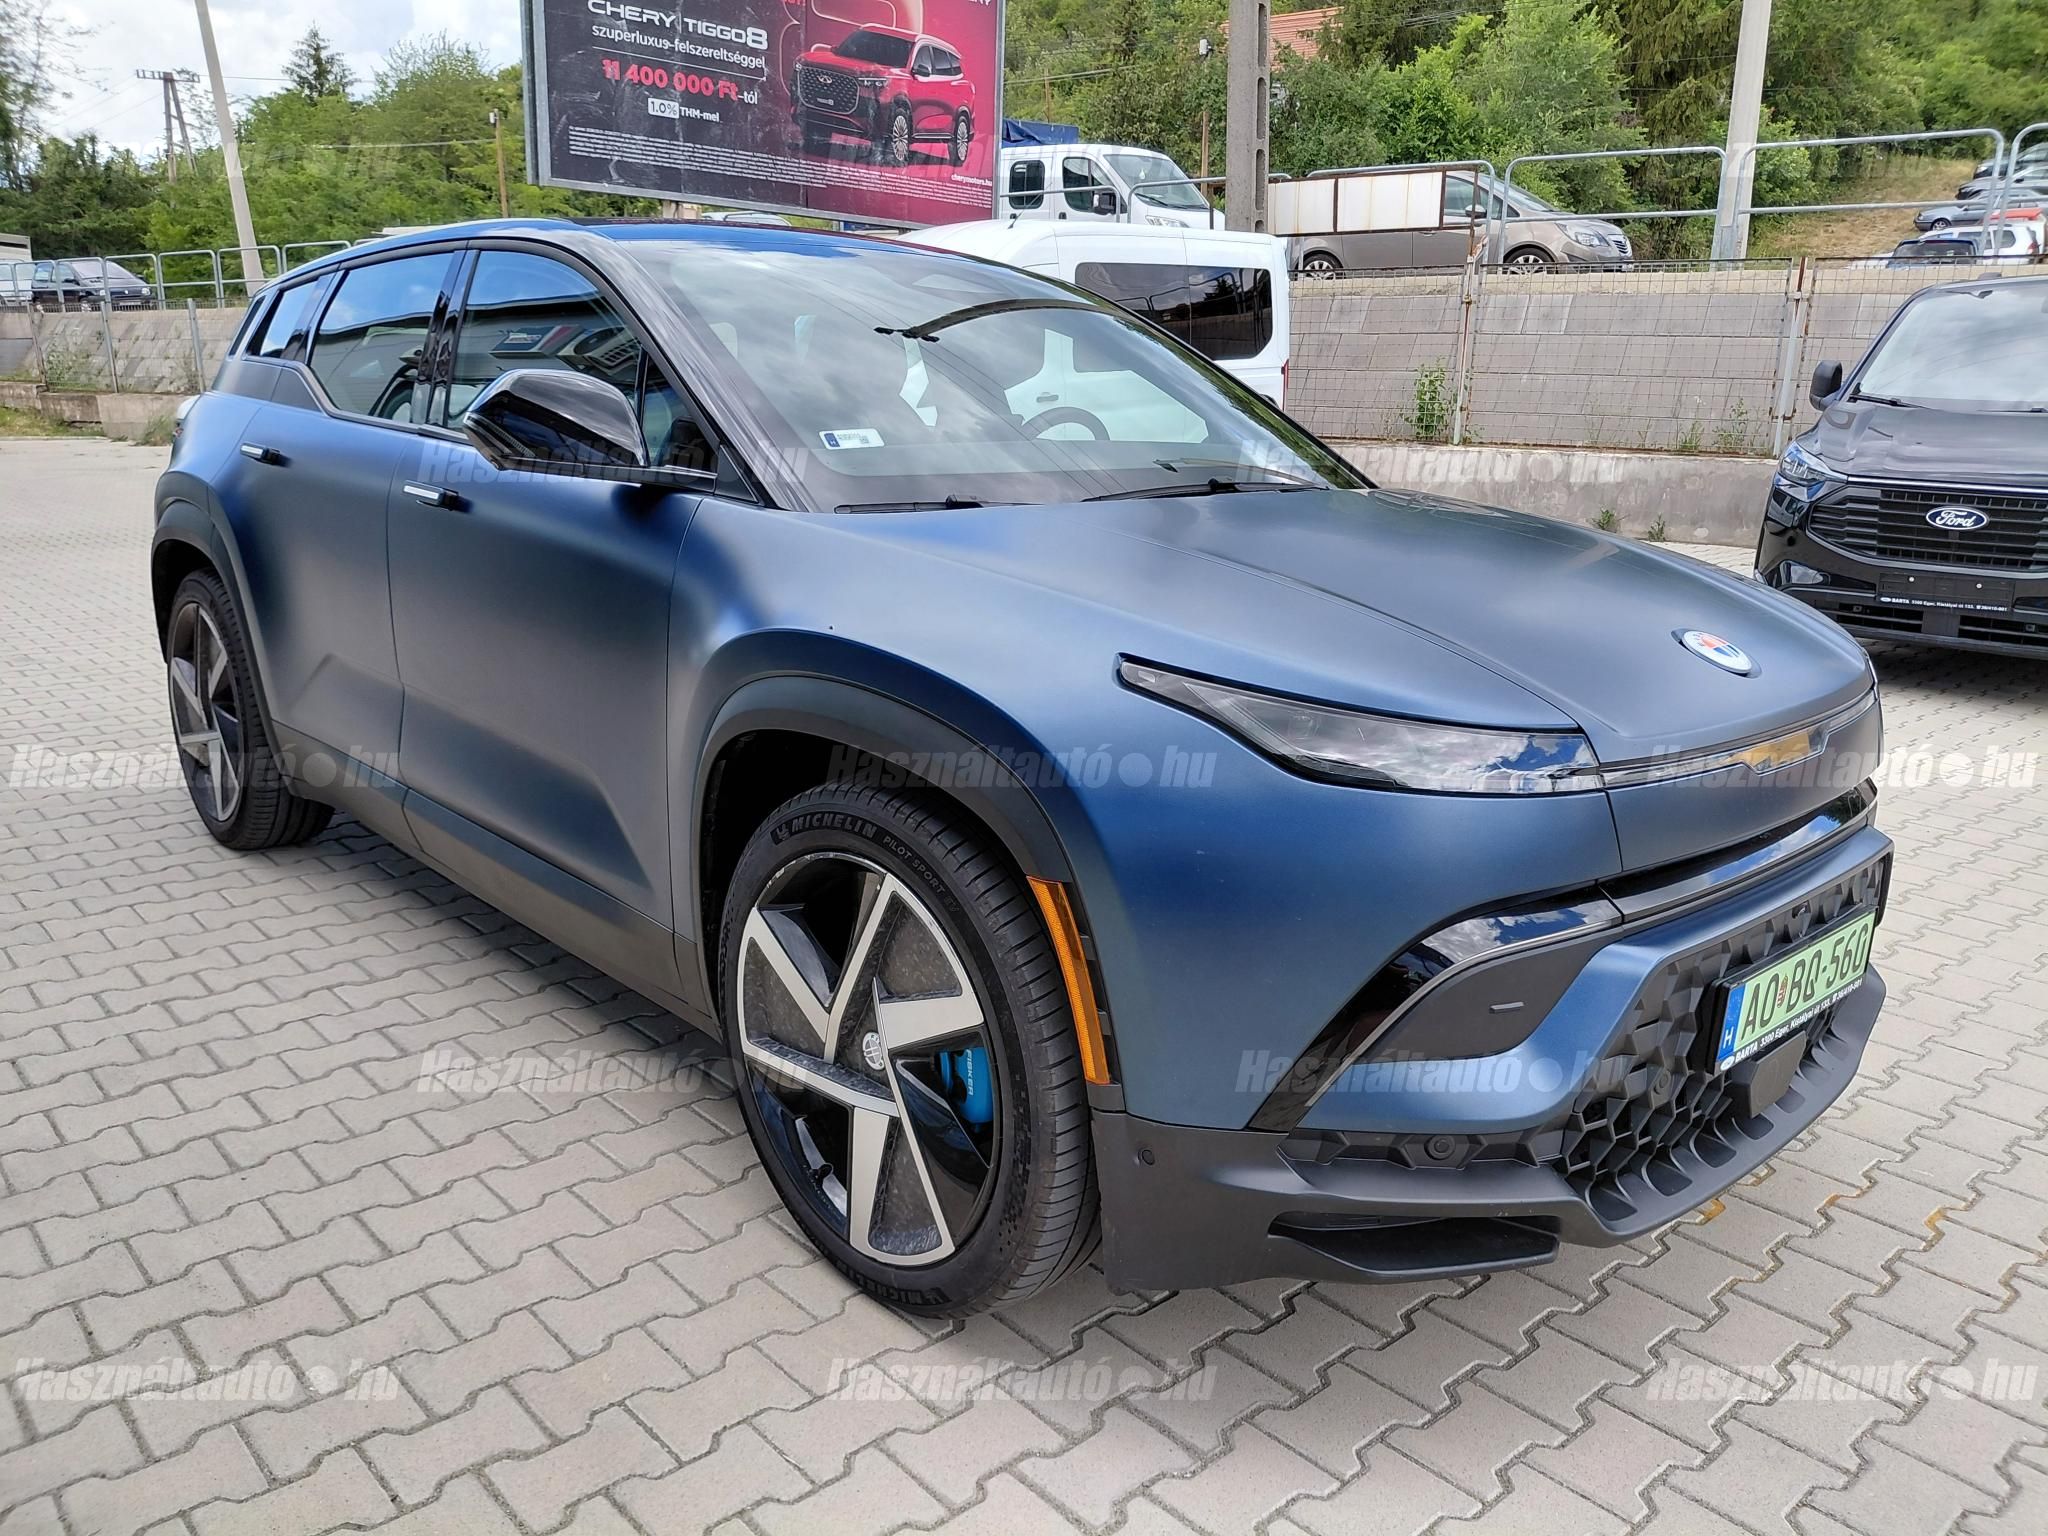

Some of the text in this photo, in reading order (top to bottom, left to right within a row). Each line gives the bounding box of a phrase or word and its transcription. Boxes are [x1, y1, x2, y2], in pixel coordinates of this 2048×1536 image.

[587, 0, 676, 28] CHERY
[592, 25, 766, 69] szuperluxus-felszereltséggel
[602, 59, 621, 80] 11
[625, 63, 669, 88] 400
[673, 72, 714, 96] 000
[650, 101, 719, 122] 1.0% THM-mel
[1935, 510, 1977, 527] Ford
[790, 812, 946, 894] MICHELIN PILOT SPORT
[1741, 973, 1779, 1041] AO
[1723, 1026, 1734, 1049] H
[1735, 1041, 1759, 1063] BARTA
[1760, 1031, 1775, 1047] 3300
[966, 1048, 974, 1096] FISKER
